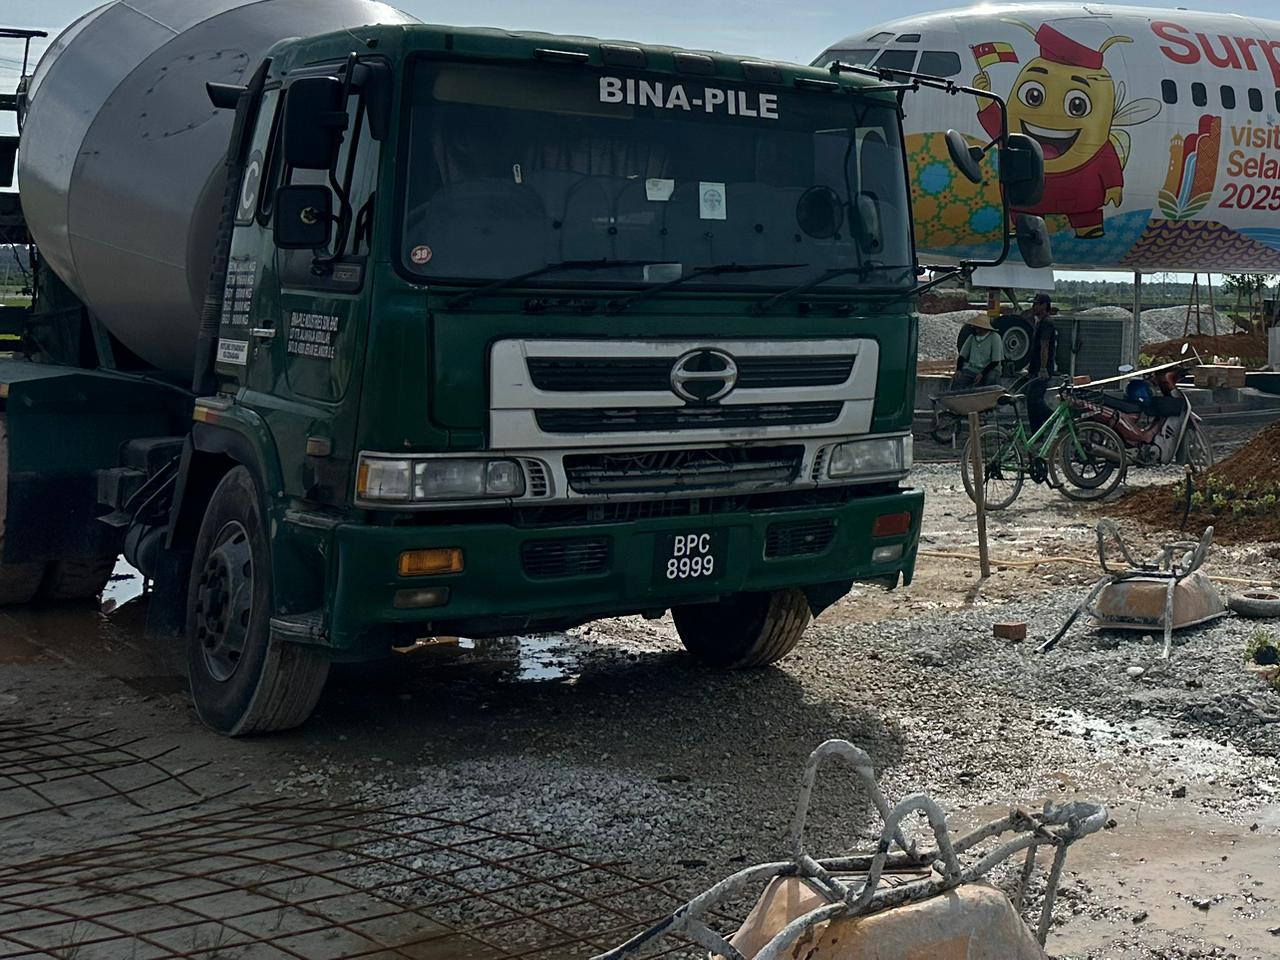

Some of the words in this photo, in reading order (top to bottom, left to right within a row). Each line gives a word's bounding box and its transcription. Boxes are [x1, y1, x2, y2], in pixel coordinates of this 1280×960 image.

[600, 76, 779, 119] BINA-PILE
[243, 160, 259, 209] C
[674, 533, 711, 557] BPC
[666, 555, 714, 579] 8999
